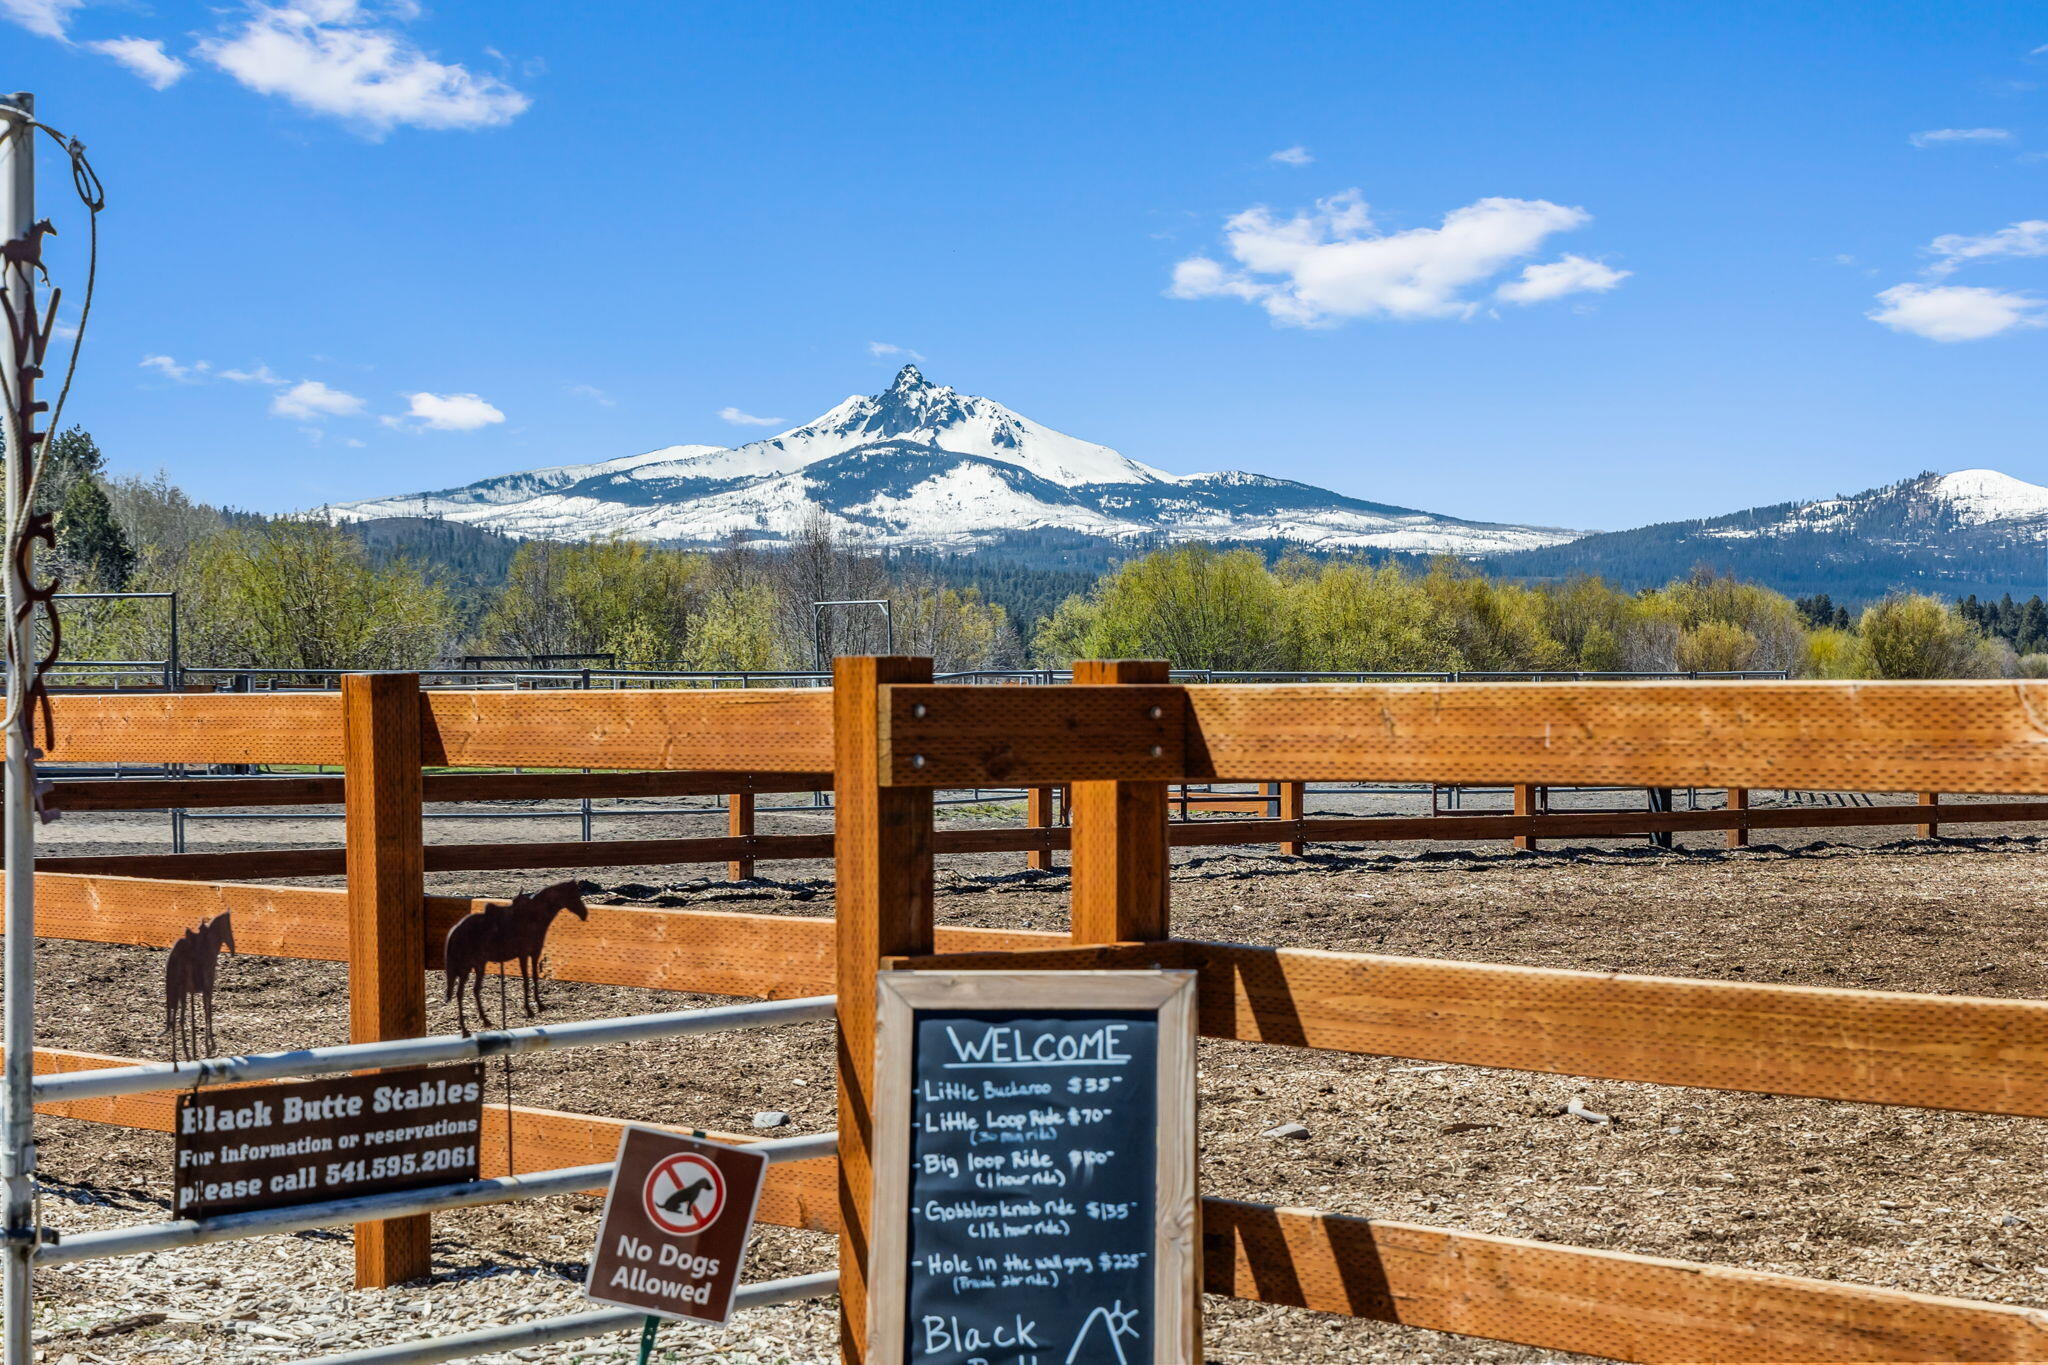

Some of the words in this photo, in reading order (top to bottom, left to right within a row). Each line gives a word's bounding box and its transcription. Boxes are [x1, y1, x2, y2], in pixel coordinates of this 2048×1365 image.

[946, 1024, 1132, 1063] WELCOME
[181, 1099, 273, 1135] Black
[282, 1092, 364, 1124] Butte
[373, 1079, 480, 1114] Stables
[924, 1079, 979, 1102] Little
[925, 1110, 979, 1133] Little
[986, 1110, 1027, 1131] Loop
[1028, 1106, 1065, 1127] Ride
[179, 1149, 216, 1169] For
[220, 1136, 333, 1164] information
[338, 1132, 360, 1149] or
[364, 1118, 479, 1146] reservations
[179, 1178, 264, 1210] please
[269, 1166, 318, 1194] call
[325, 1145, 476, 1186] 541.595.2061
[922, 1153, 959, 1179] Big
[1011, 1148, 1054, 1169] Ride
[1044, 1197, 1077, 1216] ride
[616, 1234, 653, 1262] No
[658, 1242, 720, 1279] Dogs
[927, 1254, 973, 1276] Hole
[976, 1255, 998, 1272] in
[1002, 1253, 1032, 1272] the
[610, 1265, 713, 1305] Allowed
[921, 1313, 1039, 1355] Black
